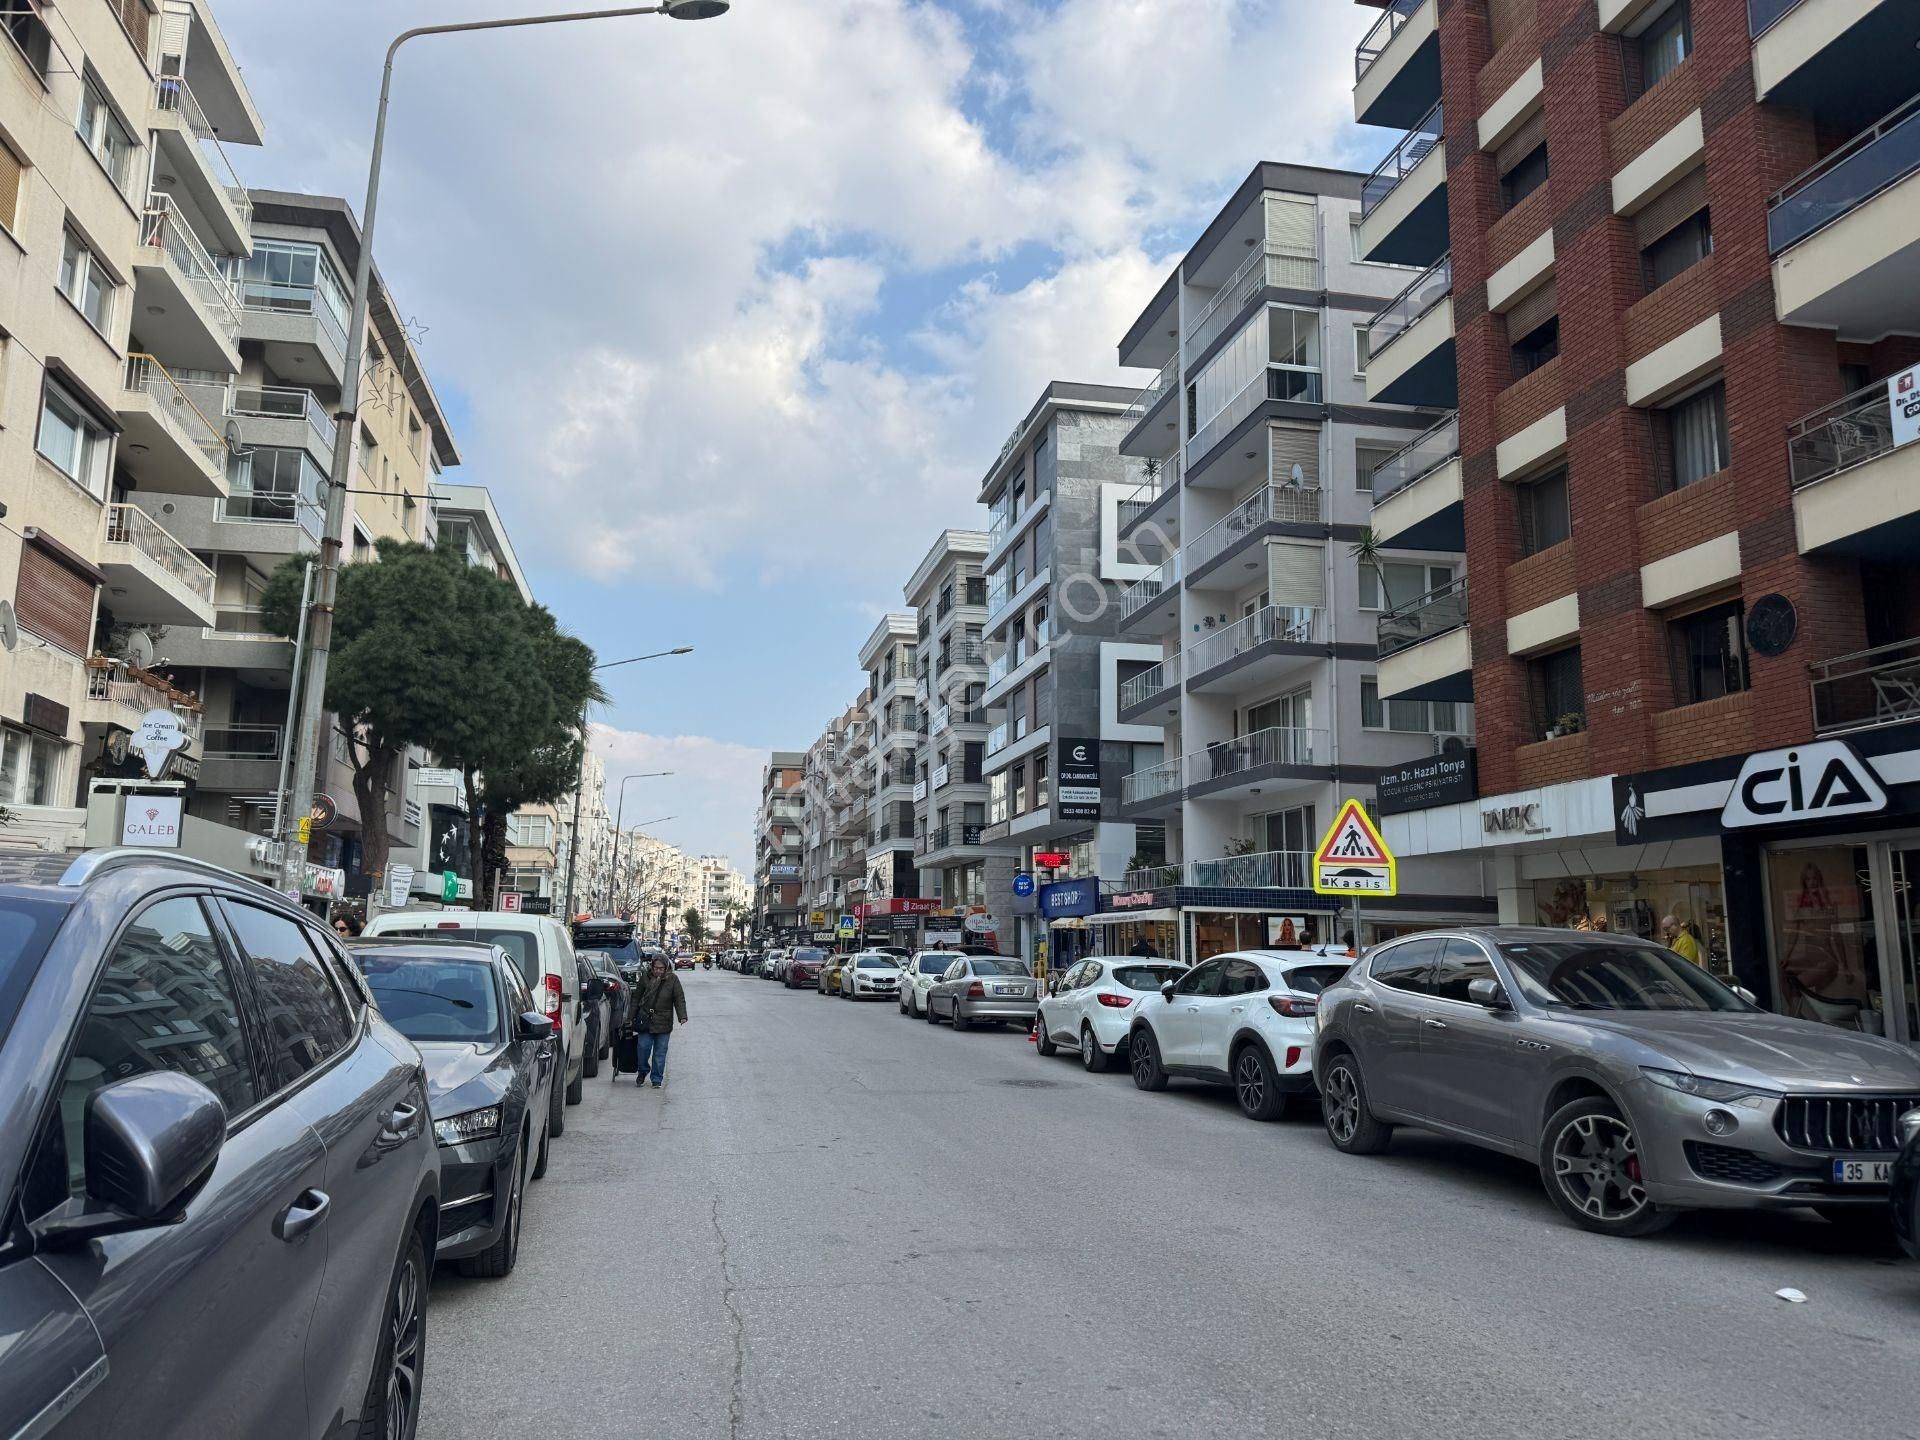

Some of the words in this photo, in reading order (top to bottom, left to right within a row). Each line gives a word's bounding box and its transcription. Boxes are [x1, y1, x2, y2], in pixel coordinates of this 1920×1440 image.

[153, 722, 175, 730] Cream
[1380, 775, 1400, 786] Uzm.
[1401, 770, 1413, 782] Dr.
[1414, 763, 1438, 779] Hazal
[1439, 759, 1466, 773] Tonya
[127, 823, 175, 835] GALEB
[1330, 878, 1380, 889] Kasis
[910, 902, 930, 910] Ziraat
[1846, 1163, 1863, 1180] 35
